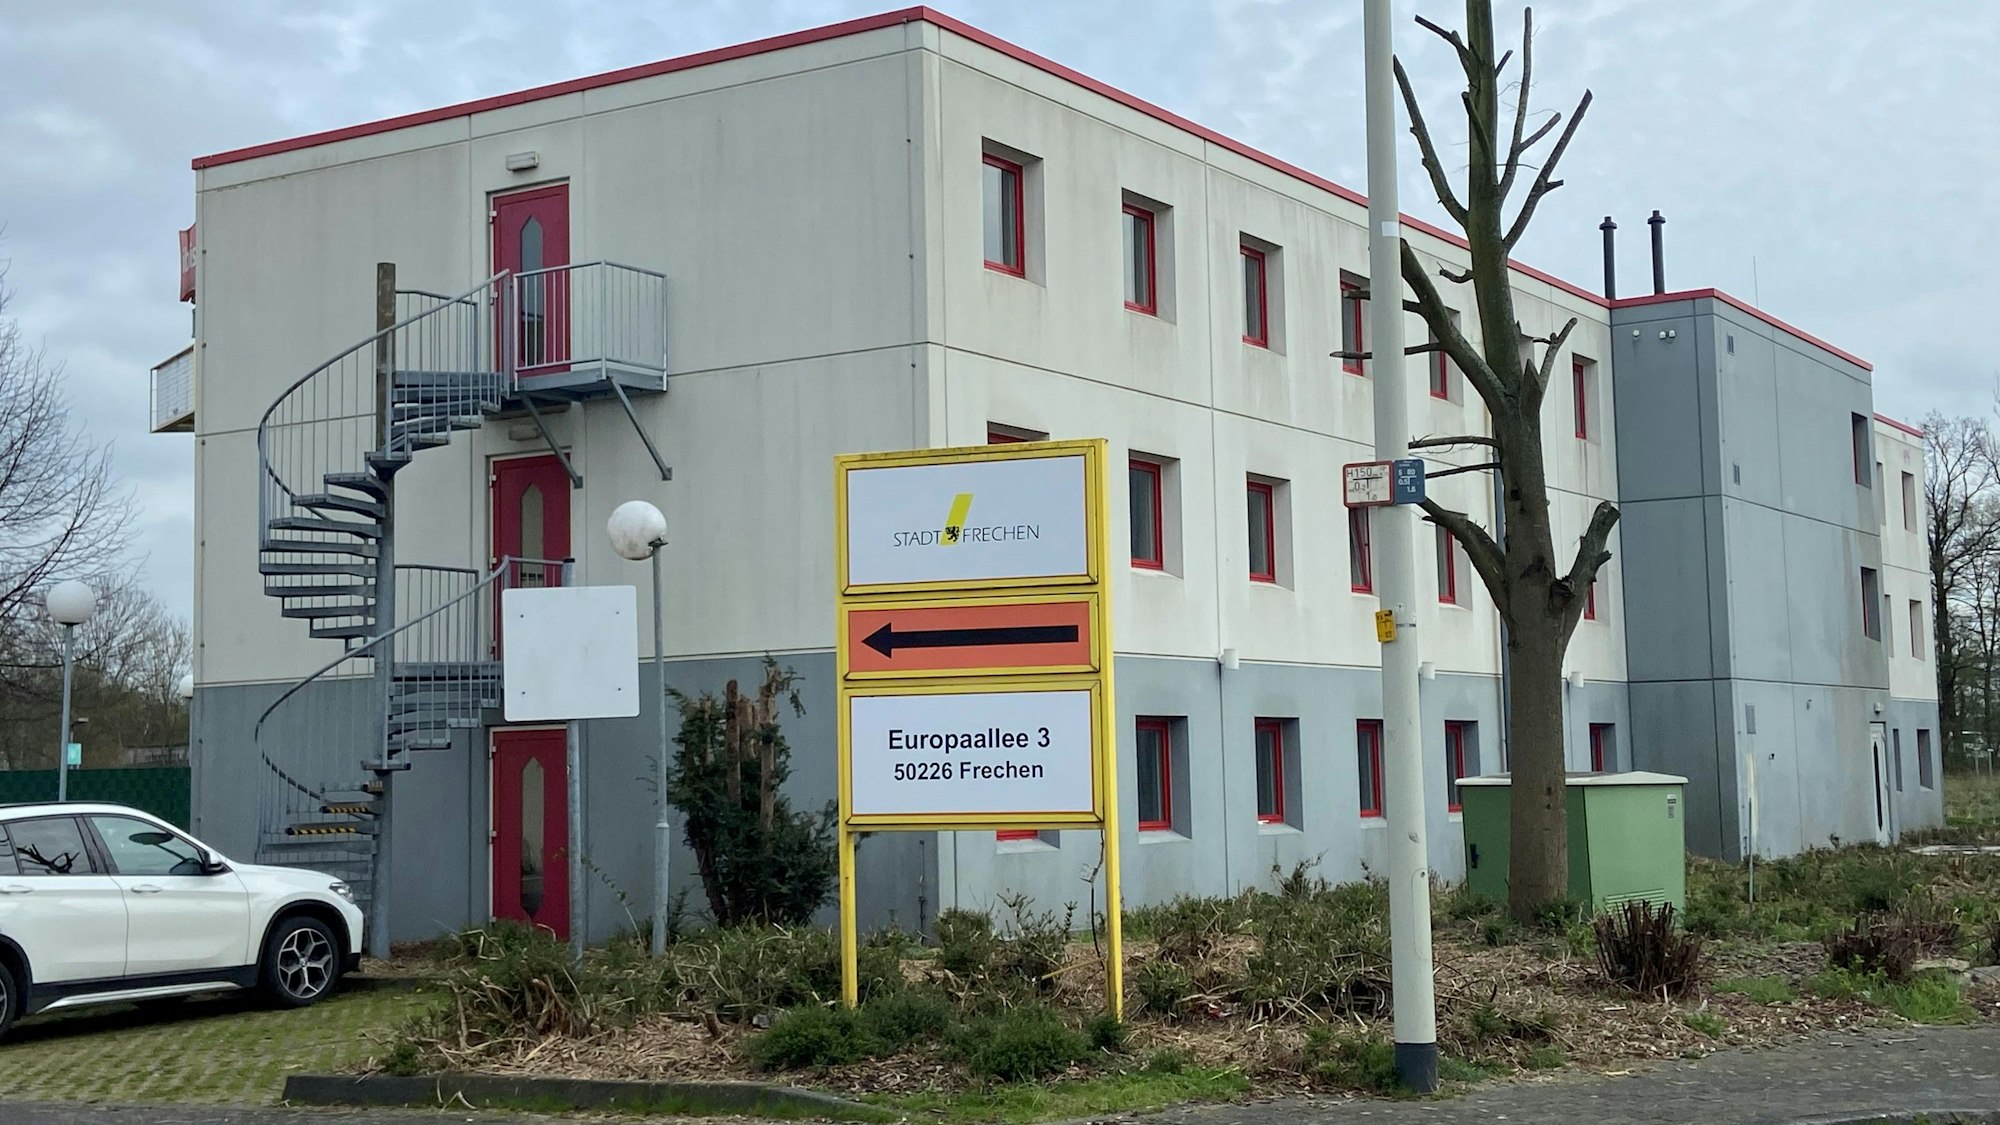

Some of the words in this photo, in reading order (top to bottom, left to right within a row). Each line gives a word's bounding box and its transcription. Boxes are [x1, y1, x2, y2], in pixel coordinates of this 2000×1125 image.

[893, 530, 941, 547] STADT
[962, 524, 1040, 543] FRECHEN
[888, 727, 1029, 754] Europaallee
[1037, 727, 1051, 748] 3
[894, 762, 953, 781] 50226
[960, 760, 1044, 779] Frechen
